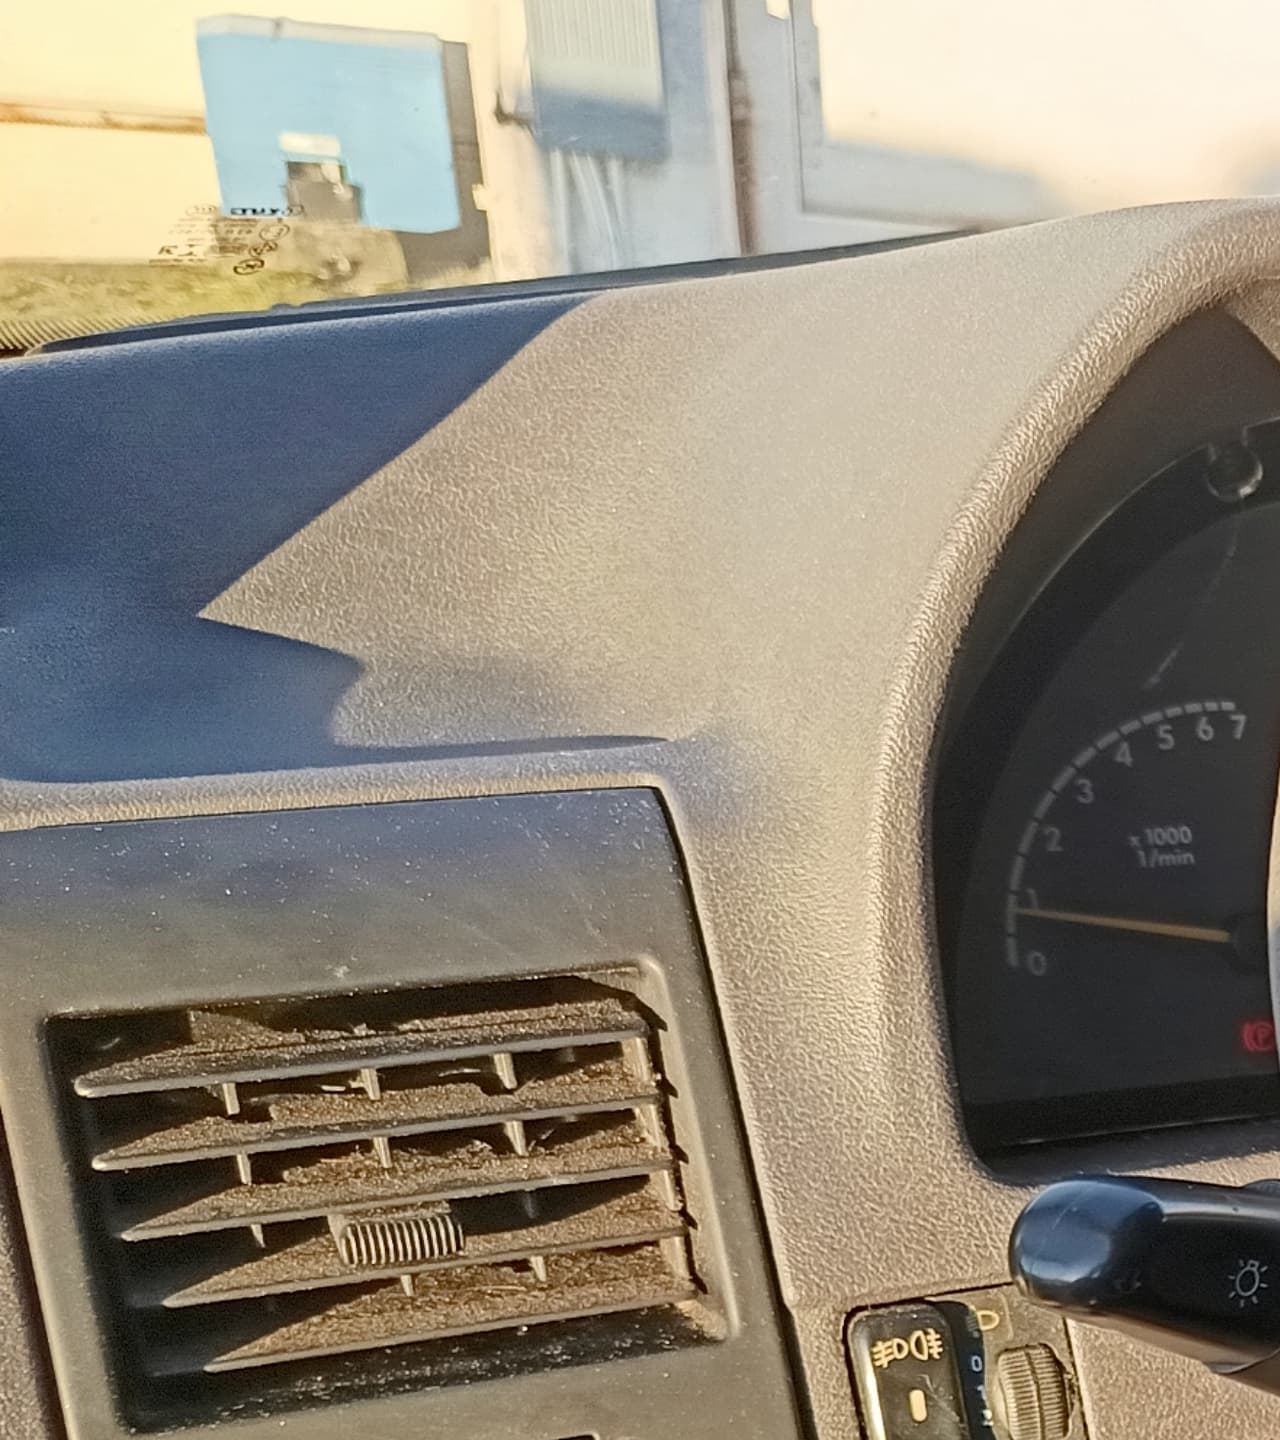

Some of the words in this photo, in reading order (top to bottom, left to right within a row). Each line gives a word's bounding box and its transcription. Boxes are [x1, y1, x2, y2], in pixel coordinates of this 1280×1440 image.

[1157, 725, 1175, 751] 5
[1196, 717, 1213, 742] 6
[1231, 715, 1248, 741] 7
[1113, 743, 1133, 769] 4
[1075, 779, 1095, 803] 3
[1042, 827, 1064, 852] 2
[1145, 826, 1193, 847] 1000
[1137, 848, 1196, 868] 1/min
[1027, 952, 1048, 977] 0
